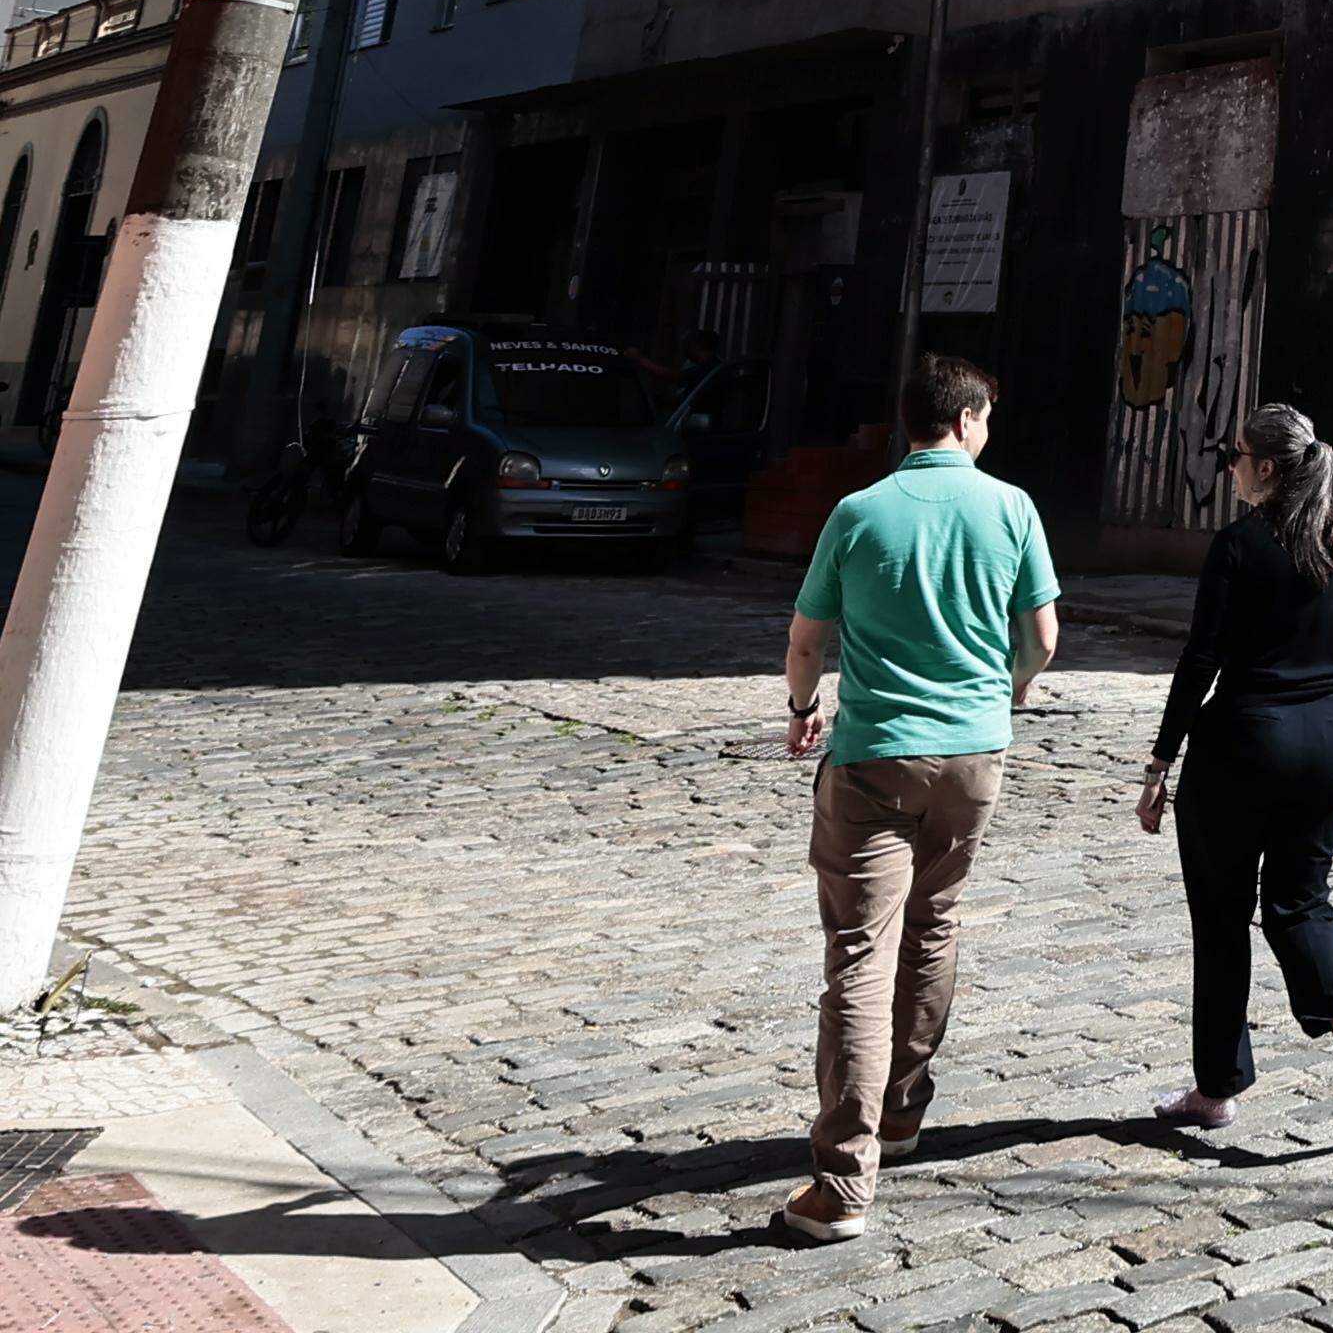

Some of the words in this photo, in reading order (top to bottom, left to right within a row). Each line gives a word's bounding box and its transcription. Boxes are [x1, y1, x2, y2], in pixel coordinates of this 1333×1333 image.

[490, 341, 541, 351] NEVES
[546, 341, 557, 349] &
[561, 342, 618, 355] SANTOS
[495, 363, 603, 374] TELHADO
